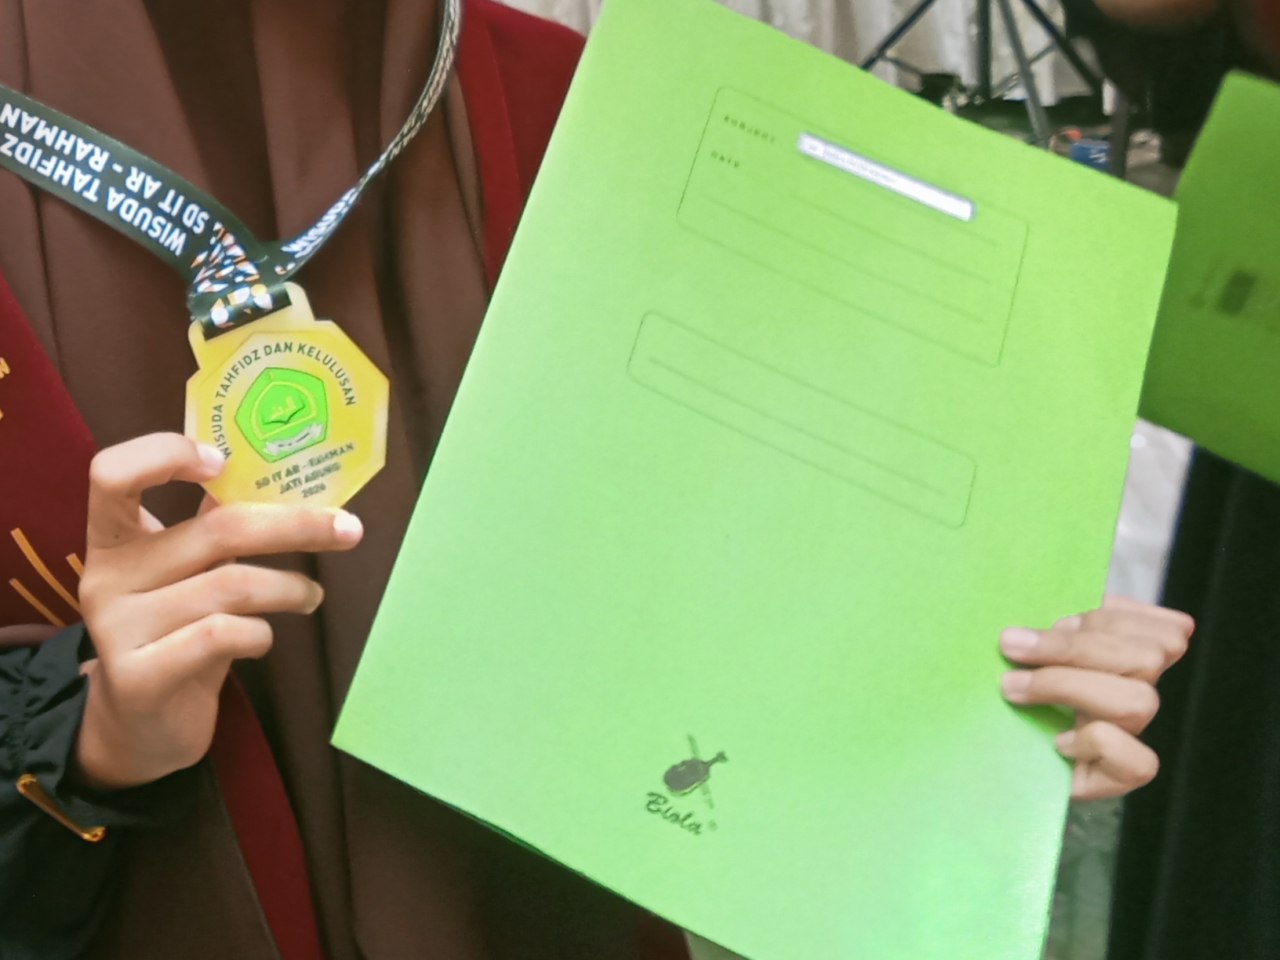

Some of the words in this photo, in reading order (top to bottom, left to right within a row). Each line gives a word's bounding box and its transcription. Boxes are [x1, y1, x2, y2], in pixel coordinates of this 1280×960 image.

[0, 103, 110, 173] RAHMAN
[0, 133, 101, 203] TAHFIDZ
[125, 166, 162, 199] AR
[106, 186, 187, 257] WISUDA
[158, 189, 185, 217] IT
[182, 203, 210, 234] SD
[215, 349, 262, 398] TAHFIDZ
[263, 341, 294, 357] DAN
[297, 342, 357, 406] KELULUSAN
[212, 404, 232, 460] WISUDA
